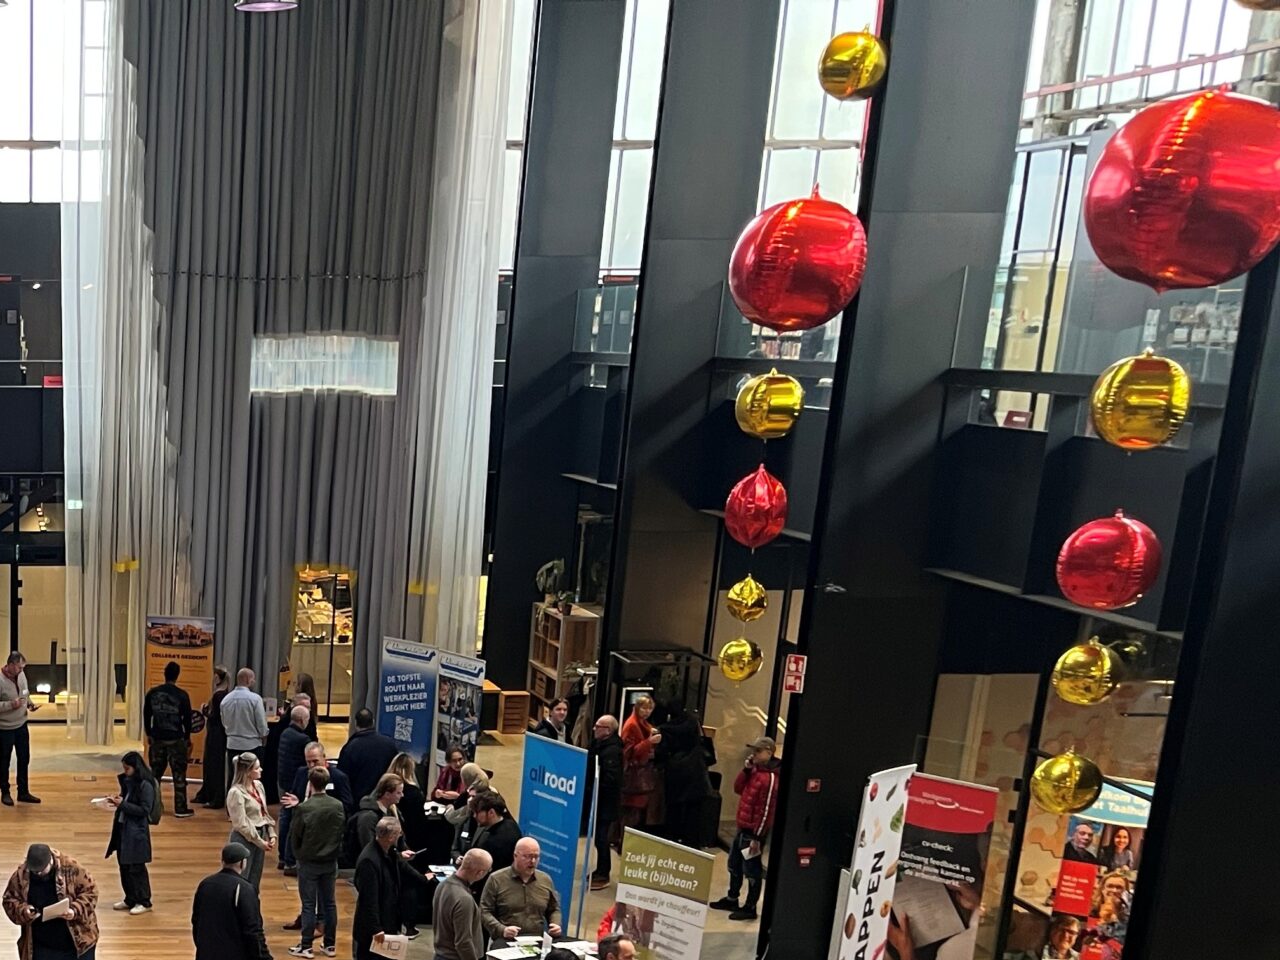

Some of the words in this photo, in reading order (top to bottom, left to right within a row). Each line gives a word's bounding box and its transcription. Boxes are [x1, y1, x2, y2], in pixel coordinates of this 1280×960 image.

[384, 684, 406, 693] ROUTE
[407, 683, 425, 691] NAAR
[529, 765, 577, 796] allroad
[625, 852, 645, 864] Zoek
[657, 859, 677, 870] echt
[678, 863, 695, 875] een
[624, 866, 648, 880] leuke
